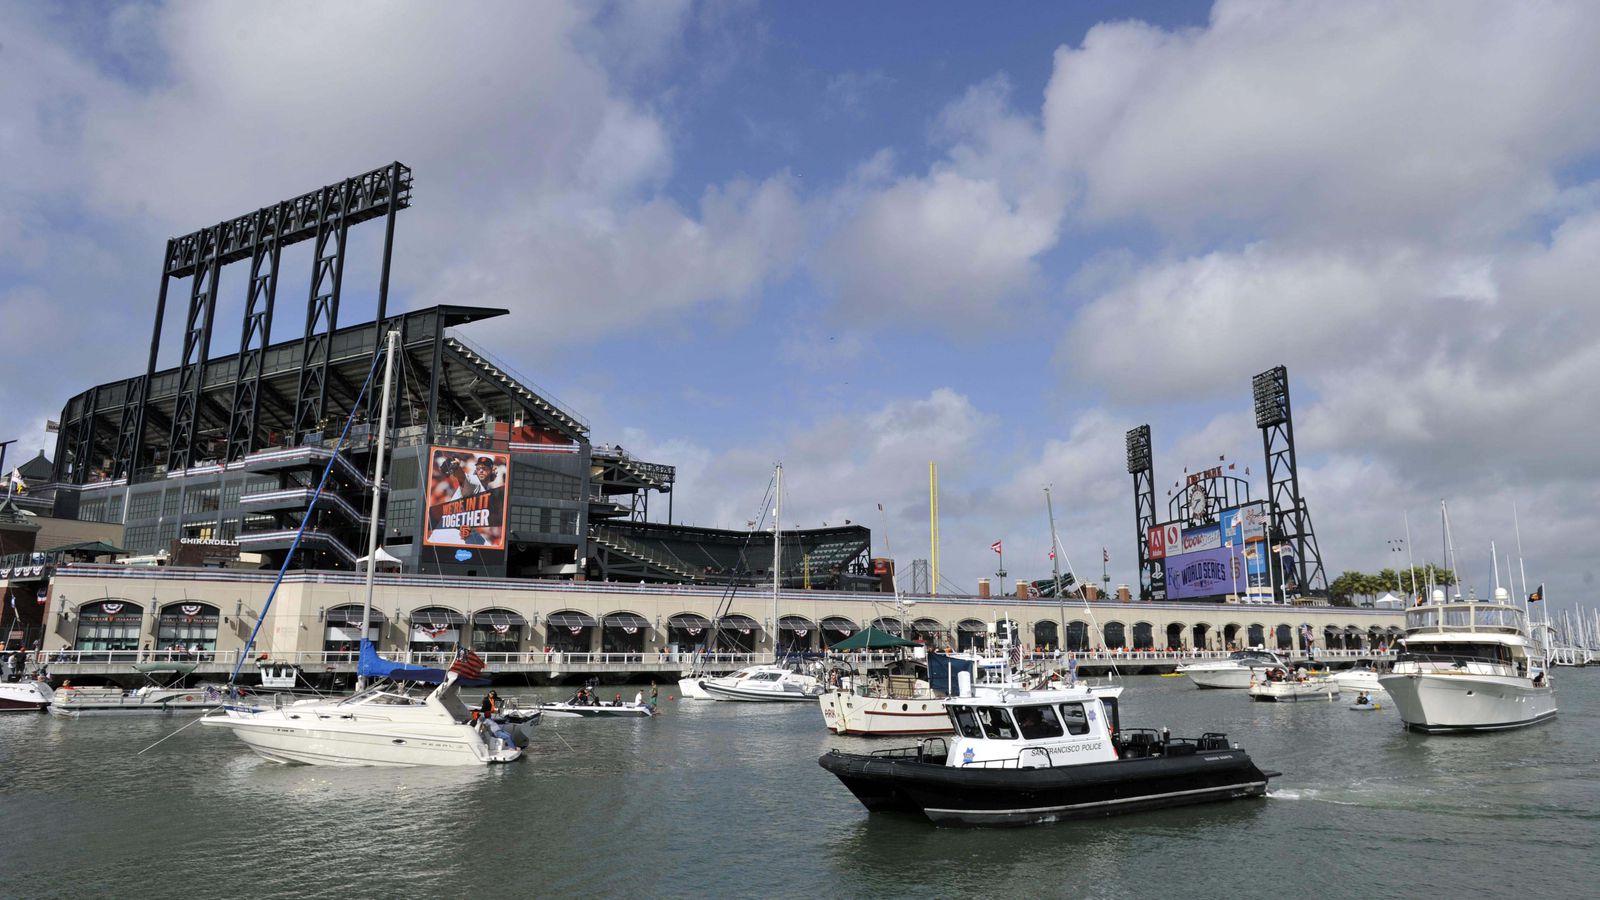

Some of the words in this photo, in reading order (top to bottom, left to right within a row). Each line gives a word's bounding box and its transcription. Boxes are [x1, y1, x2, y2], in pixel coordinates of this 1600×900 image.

[443, 500, 464, 515] WE'RE
[466, 497, 476, 511] IN
[478, 493, 491, 510] IT
[442, 509, 490, 528] TOGETHER
[180, 538, 240, 546] GHIRARDELLI
[1184, 534, 1202, 550] Coors
[1182, 562, 1202, 585] WORLD
[1203, 561, 1226, 581] SERIES
[1031, 749, 1044, 757] SAN
[1046, 745, 1080, 755] FRANCISCO
[1082, 743, 1102, 751] POLICE
